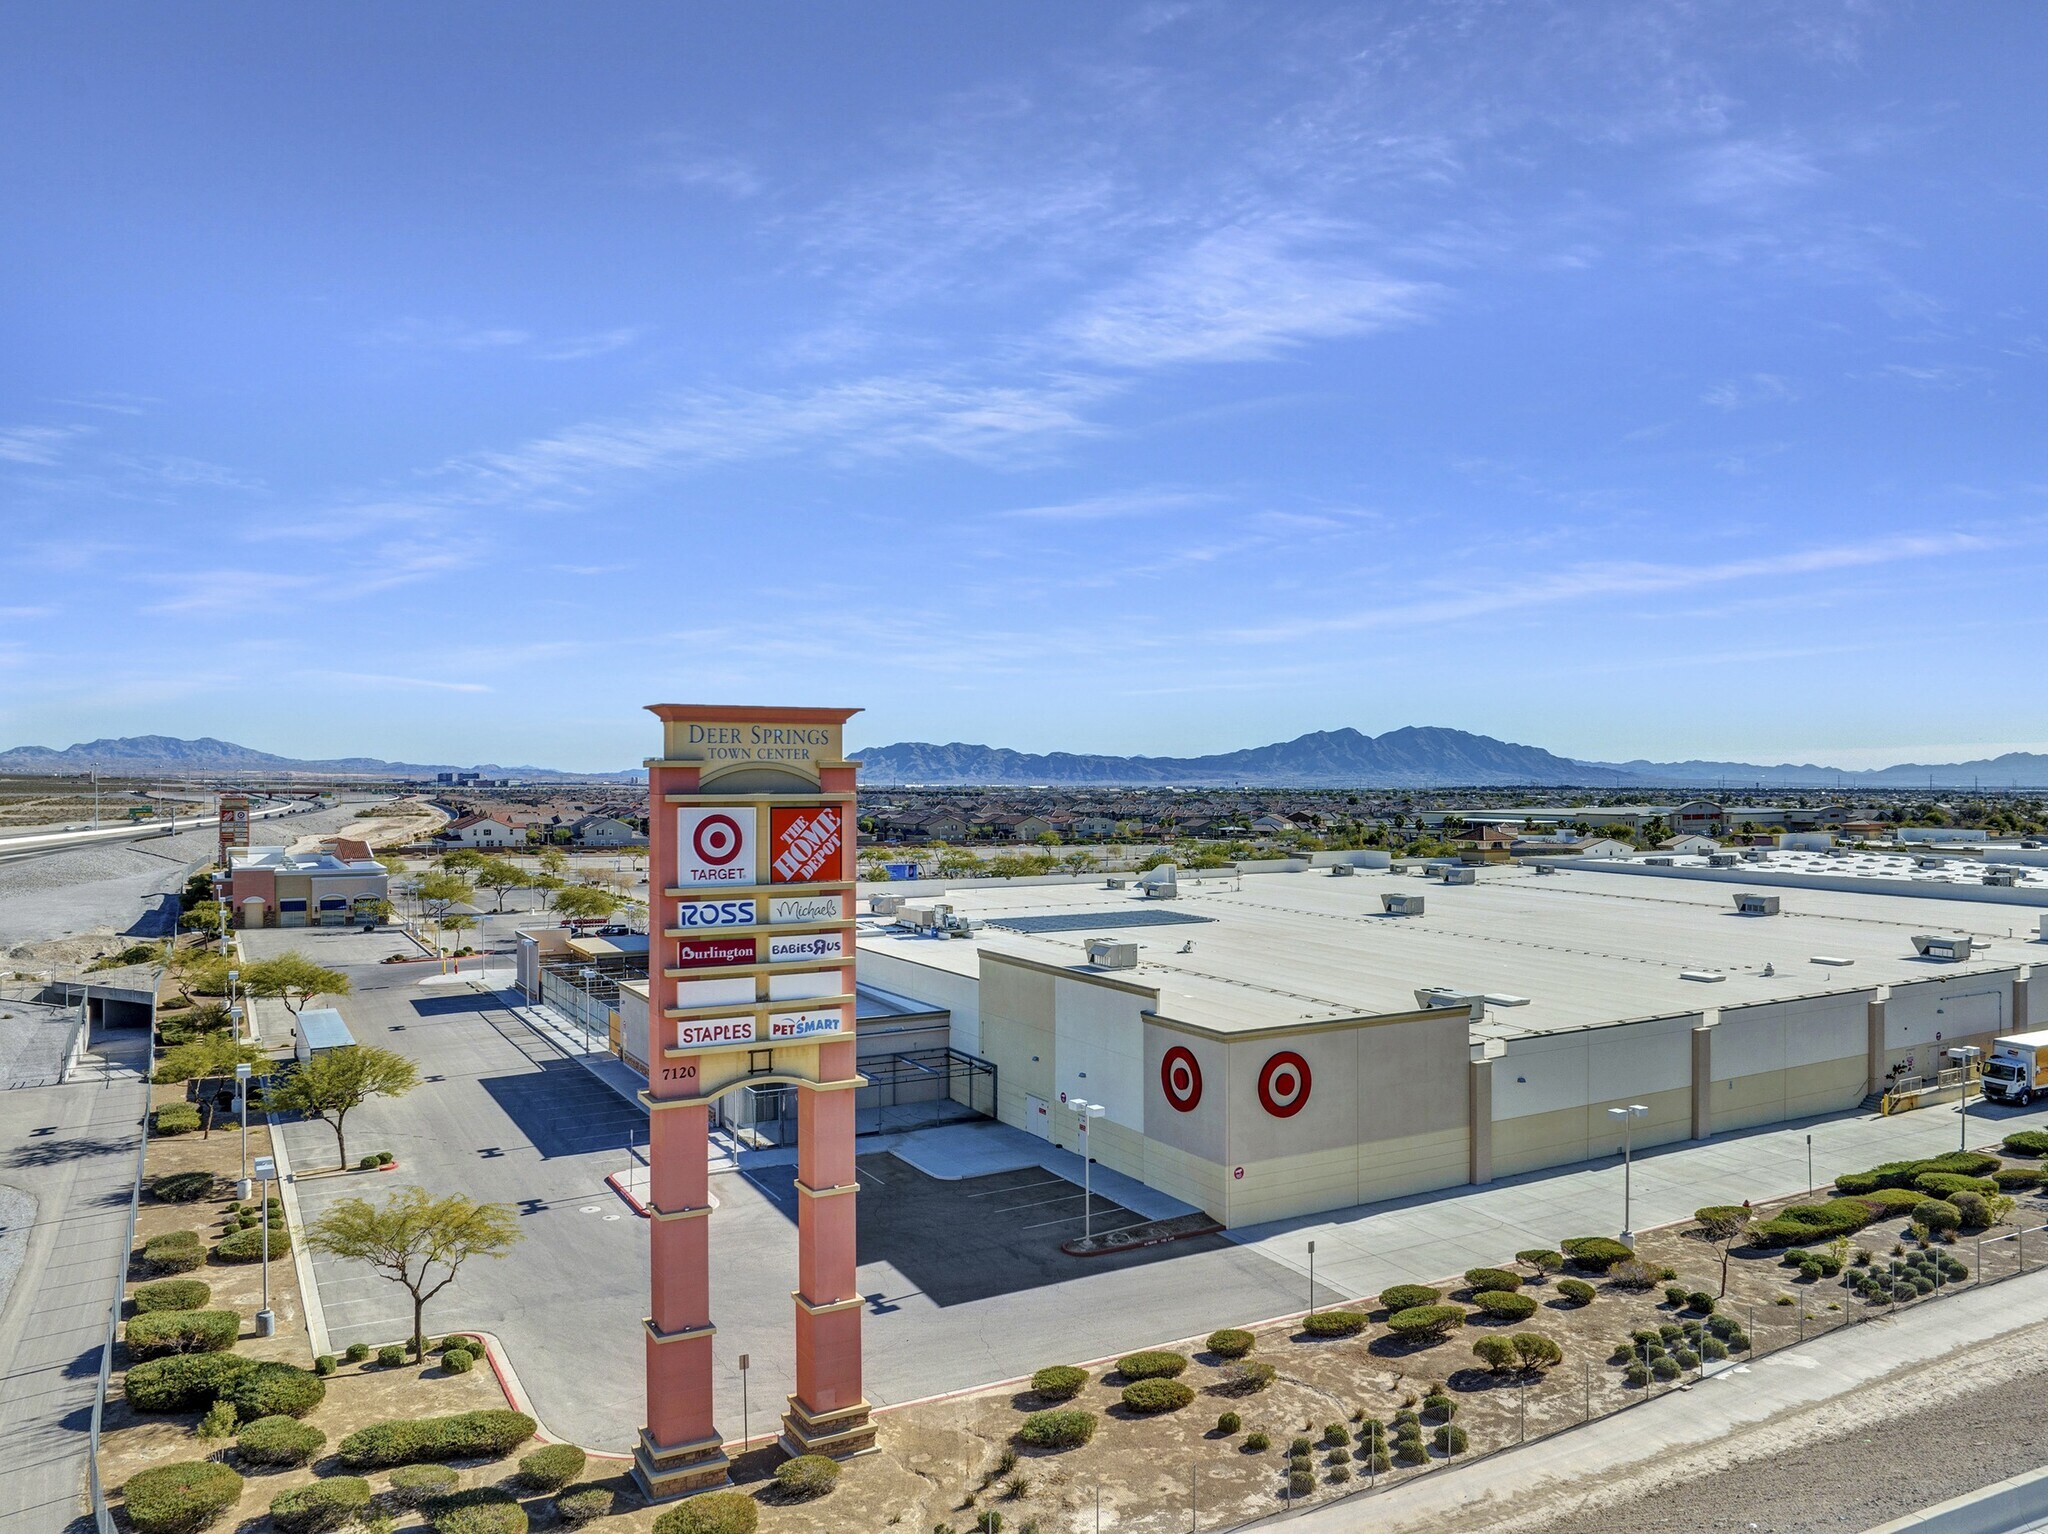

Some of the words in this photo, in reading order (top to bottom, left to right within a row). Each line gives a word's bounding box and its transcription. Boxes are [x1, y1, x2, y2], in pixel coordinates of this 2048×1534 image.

[689, 725, 741, 744] DEER
[751, 725, 829, 745] SPRINGS
[707, 748, 750, 759] TOWN
[757, 749, 810, 759] CENTER
[780, 816, 809, 845] THE
[772, 808, 841, 881] HOME
[799, 833, 841, 880] DEPOT
[690, 868, 745, 881] TARGET
[681, 902, 754, 926] ROSS
[776, 899, 837, 919] Michaels
[681, 946, 754, 961] Burlington
[683, 1023, 752, 1044] STAPLES
[662, 1066, 696, 1080] 7120
